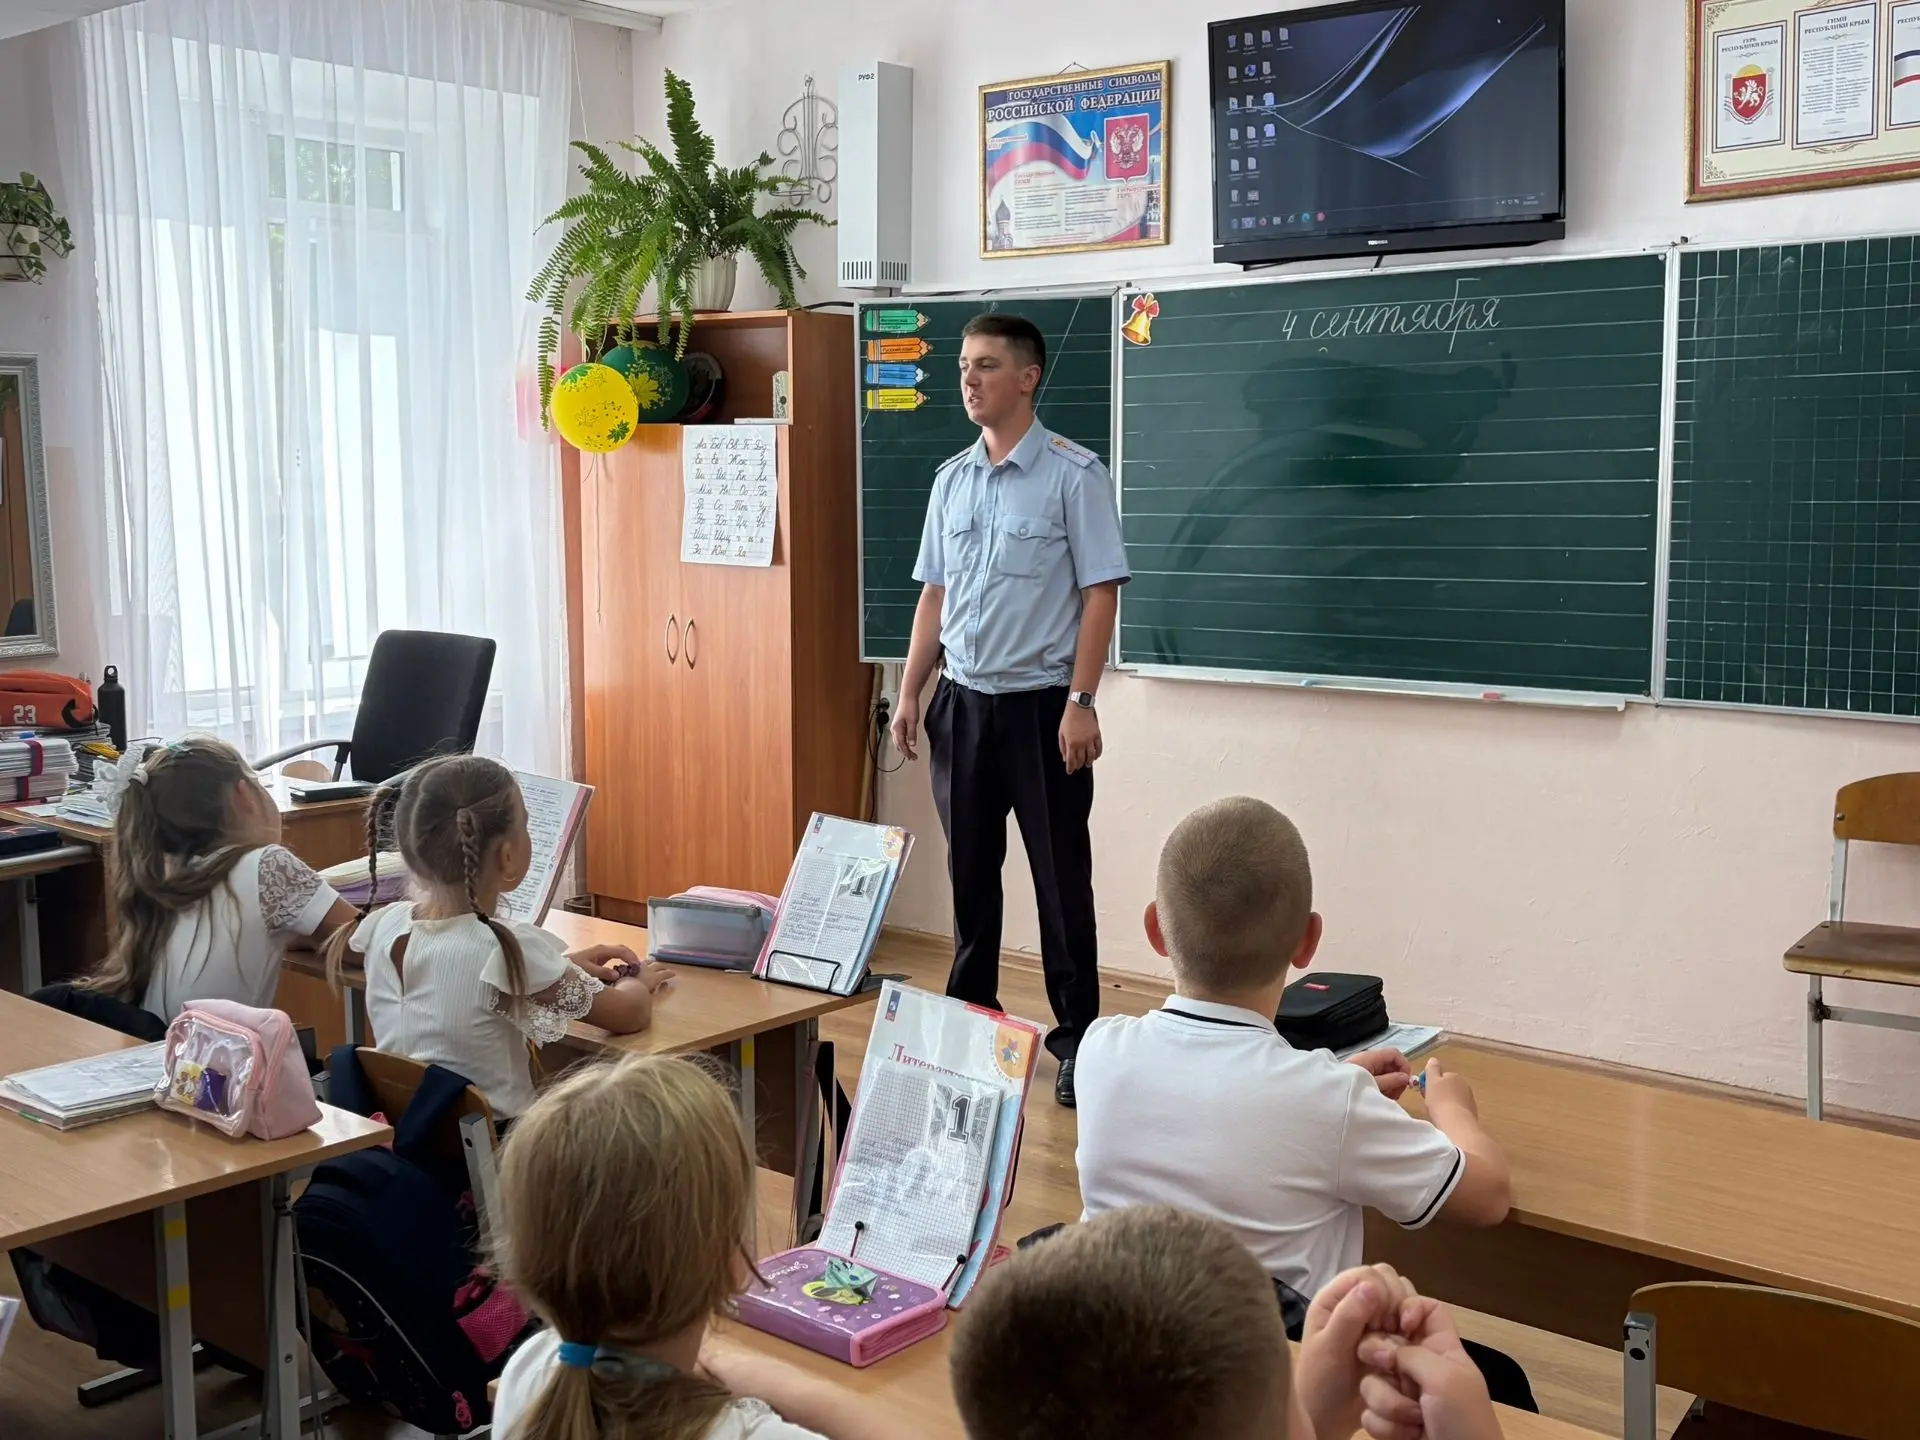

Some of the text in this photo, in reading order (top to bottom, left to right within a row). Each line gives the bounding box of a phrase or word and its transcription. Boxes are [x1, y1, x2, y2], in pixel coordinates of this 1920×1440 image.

[1008, 72, 1161, 101] ГОСУДАРСТВЕННЫЕ СИМВОЛЫ
[987, 89, 1161, 122] РОССИЙСКОЙ ФЕДЕРАЦИИ
[1282, 277, 1501, 354] 4 сентября
[13, 704, 37, 725] 23
[946, 1094, 972, 1144] 1
